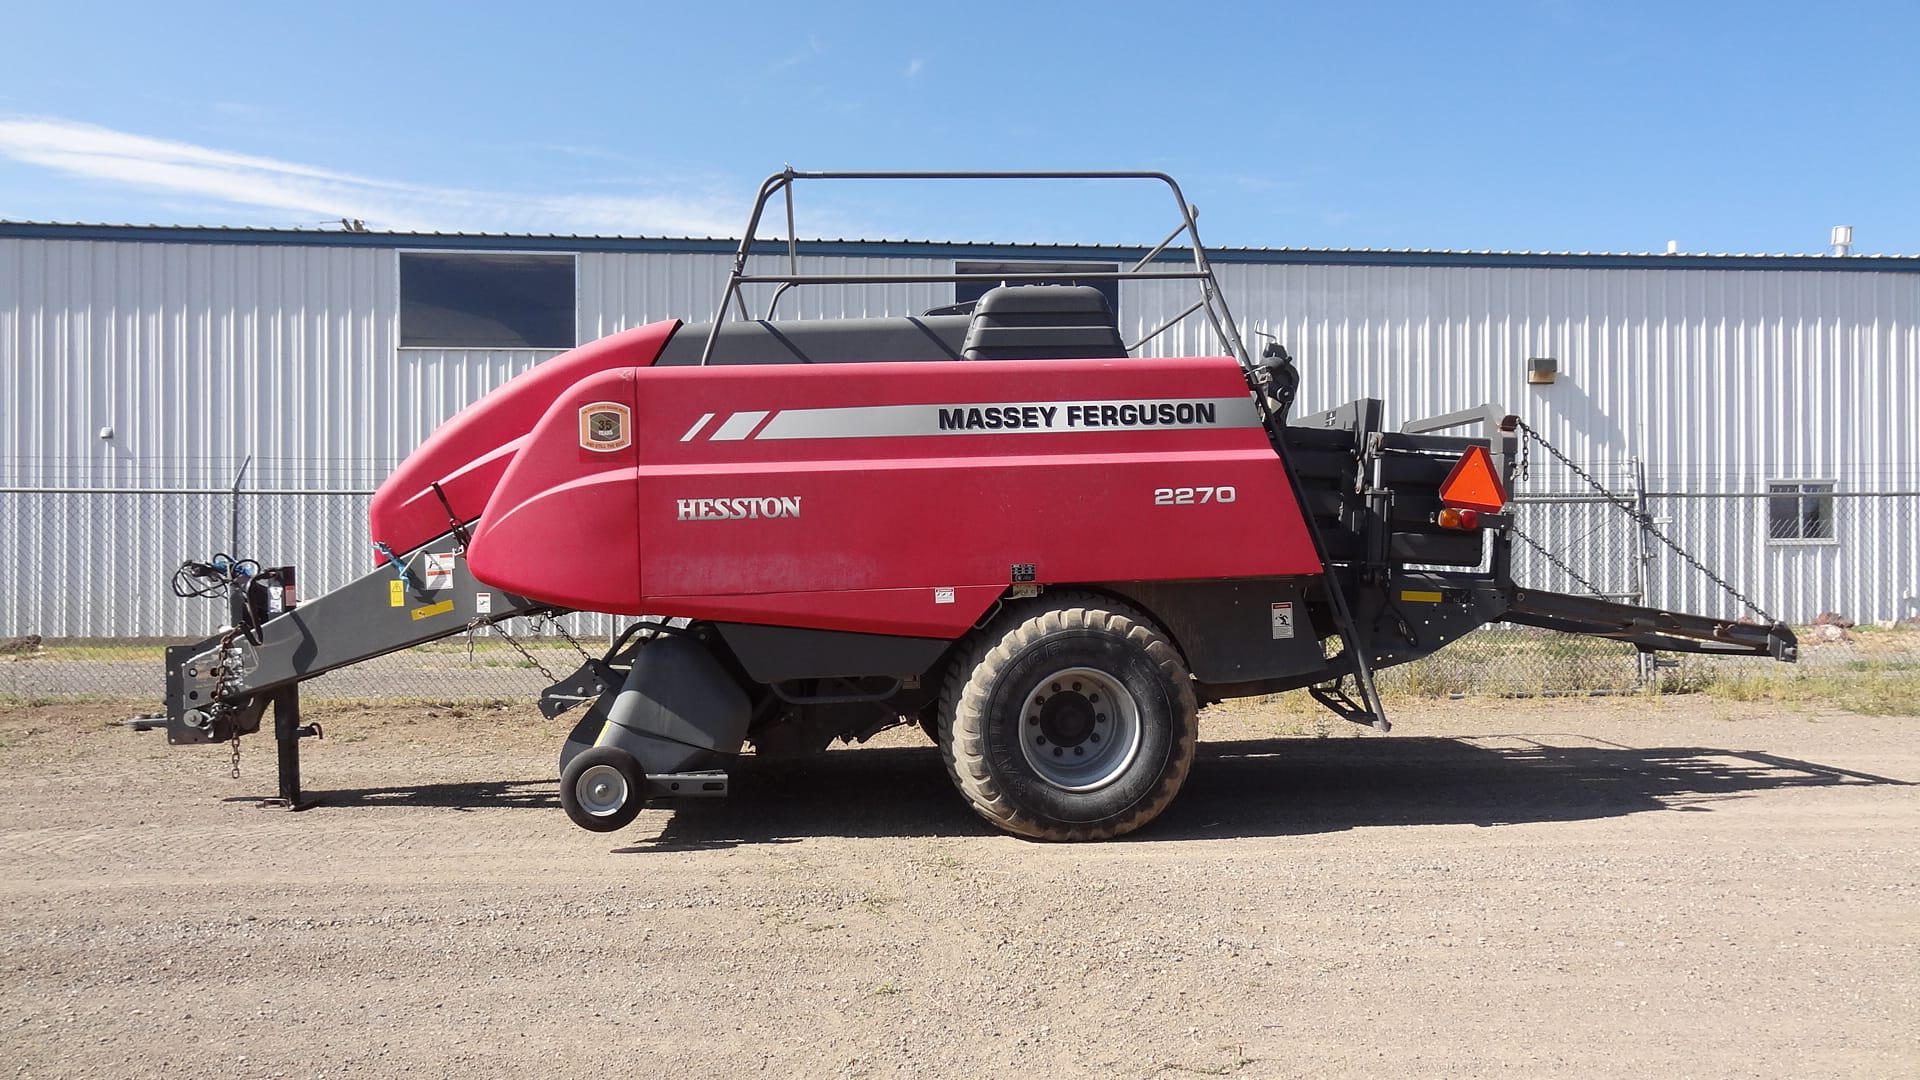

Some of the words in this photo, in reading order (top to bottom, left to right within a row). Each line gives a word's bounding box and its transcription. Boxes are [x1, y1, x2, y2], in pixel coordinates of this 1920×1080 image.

[598, 420, 612, 430] 35
[938, 406, 1057, 430] MASSEY
[1067, 402, 1217, 427] FERGUSON
[1154, 486, 1236, 505] 2270
[677, 496, 801, 520] HESSTON
